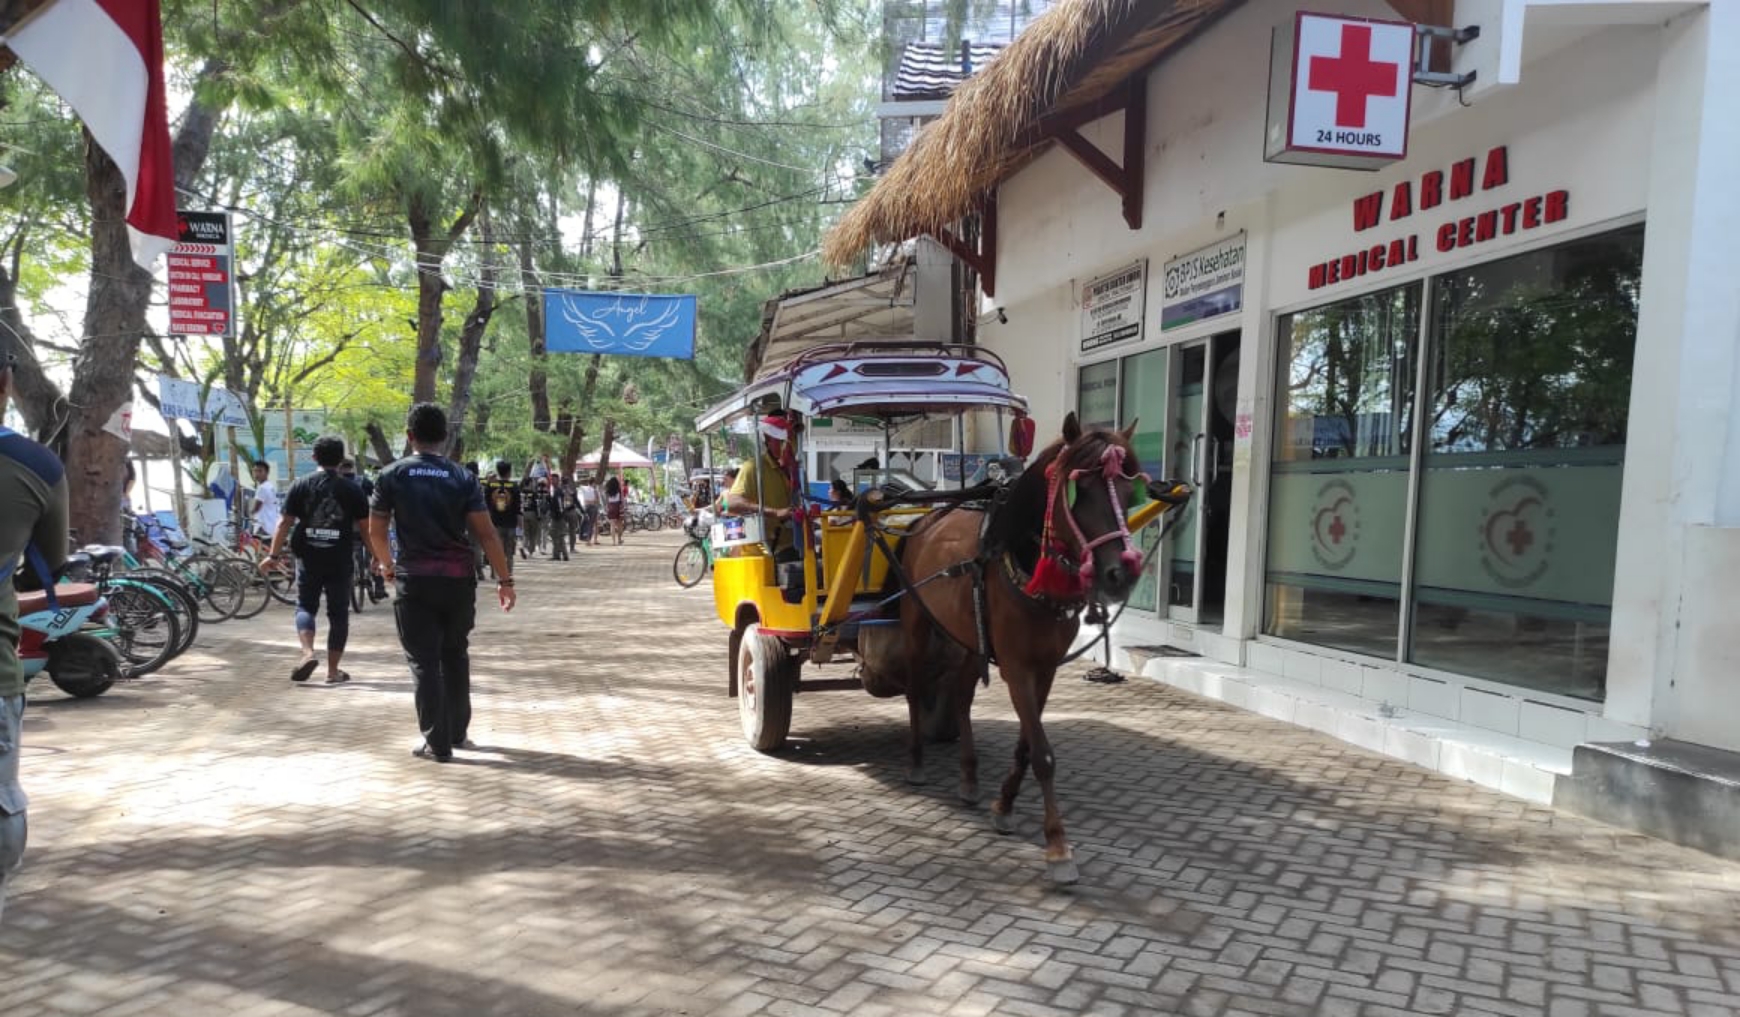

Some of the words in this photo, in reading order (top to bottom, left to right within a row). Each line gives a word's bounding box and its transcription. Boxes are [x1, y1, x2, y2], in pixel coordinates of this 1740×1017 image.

[1316, 130, 1332, 143] 24
[1336, 132, 1381, 146] HOURS
[1354, 145, 1508, 232] WARNA
[190, 222, 224, 234] WARNA
[1308, 235, 1418, 289] MEDICAL
[1436, 190, 1569, 252] CENTER
[1200, 244, 1244, 275] Kesehatan
[170, 284, 200, 293] PHARMACY
[171, 310, 192, 319] MEDICAL
[193, 311, 225, 320] EVACUATION
[592, 295, 648, 323] Angel
[408, 467, 449, 478] BRIMOB
